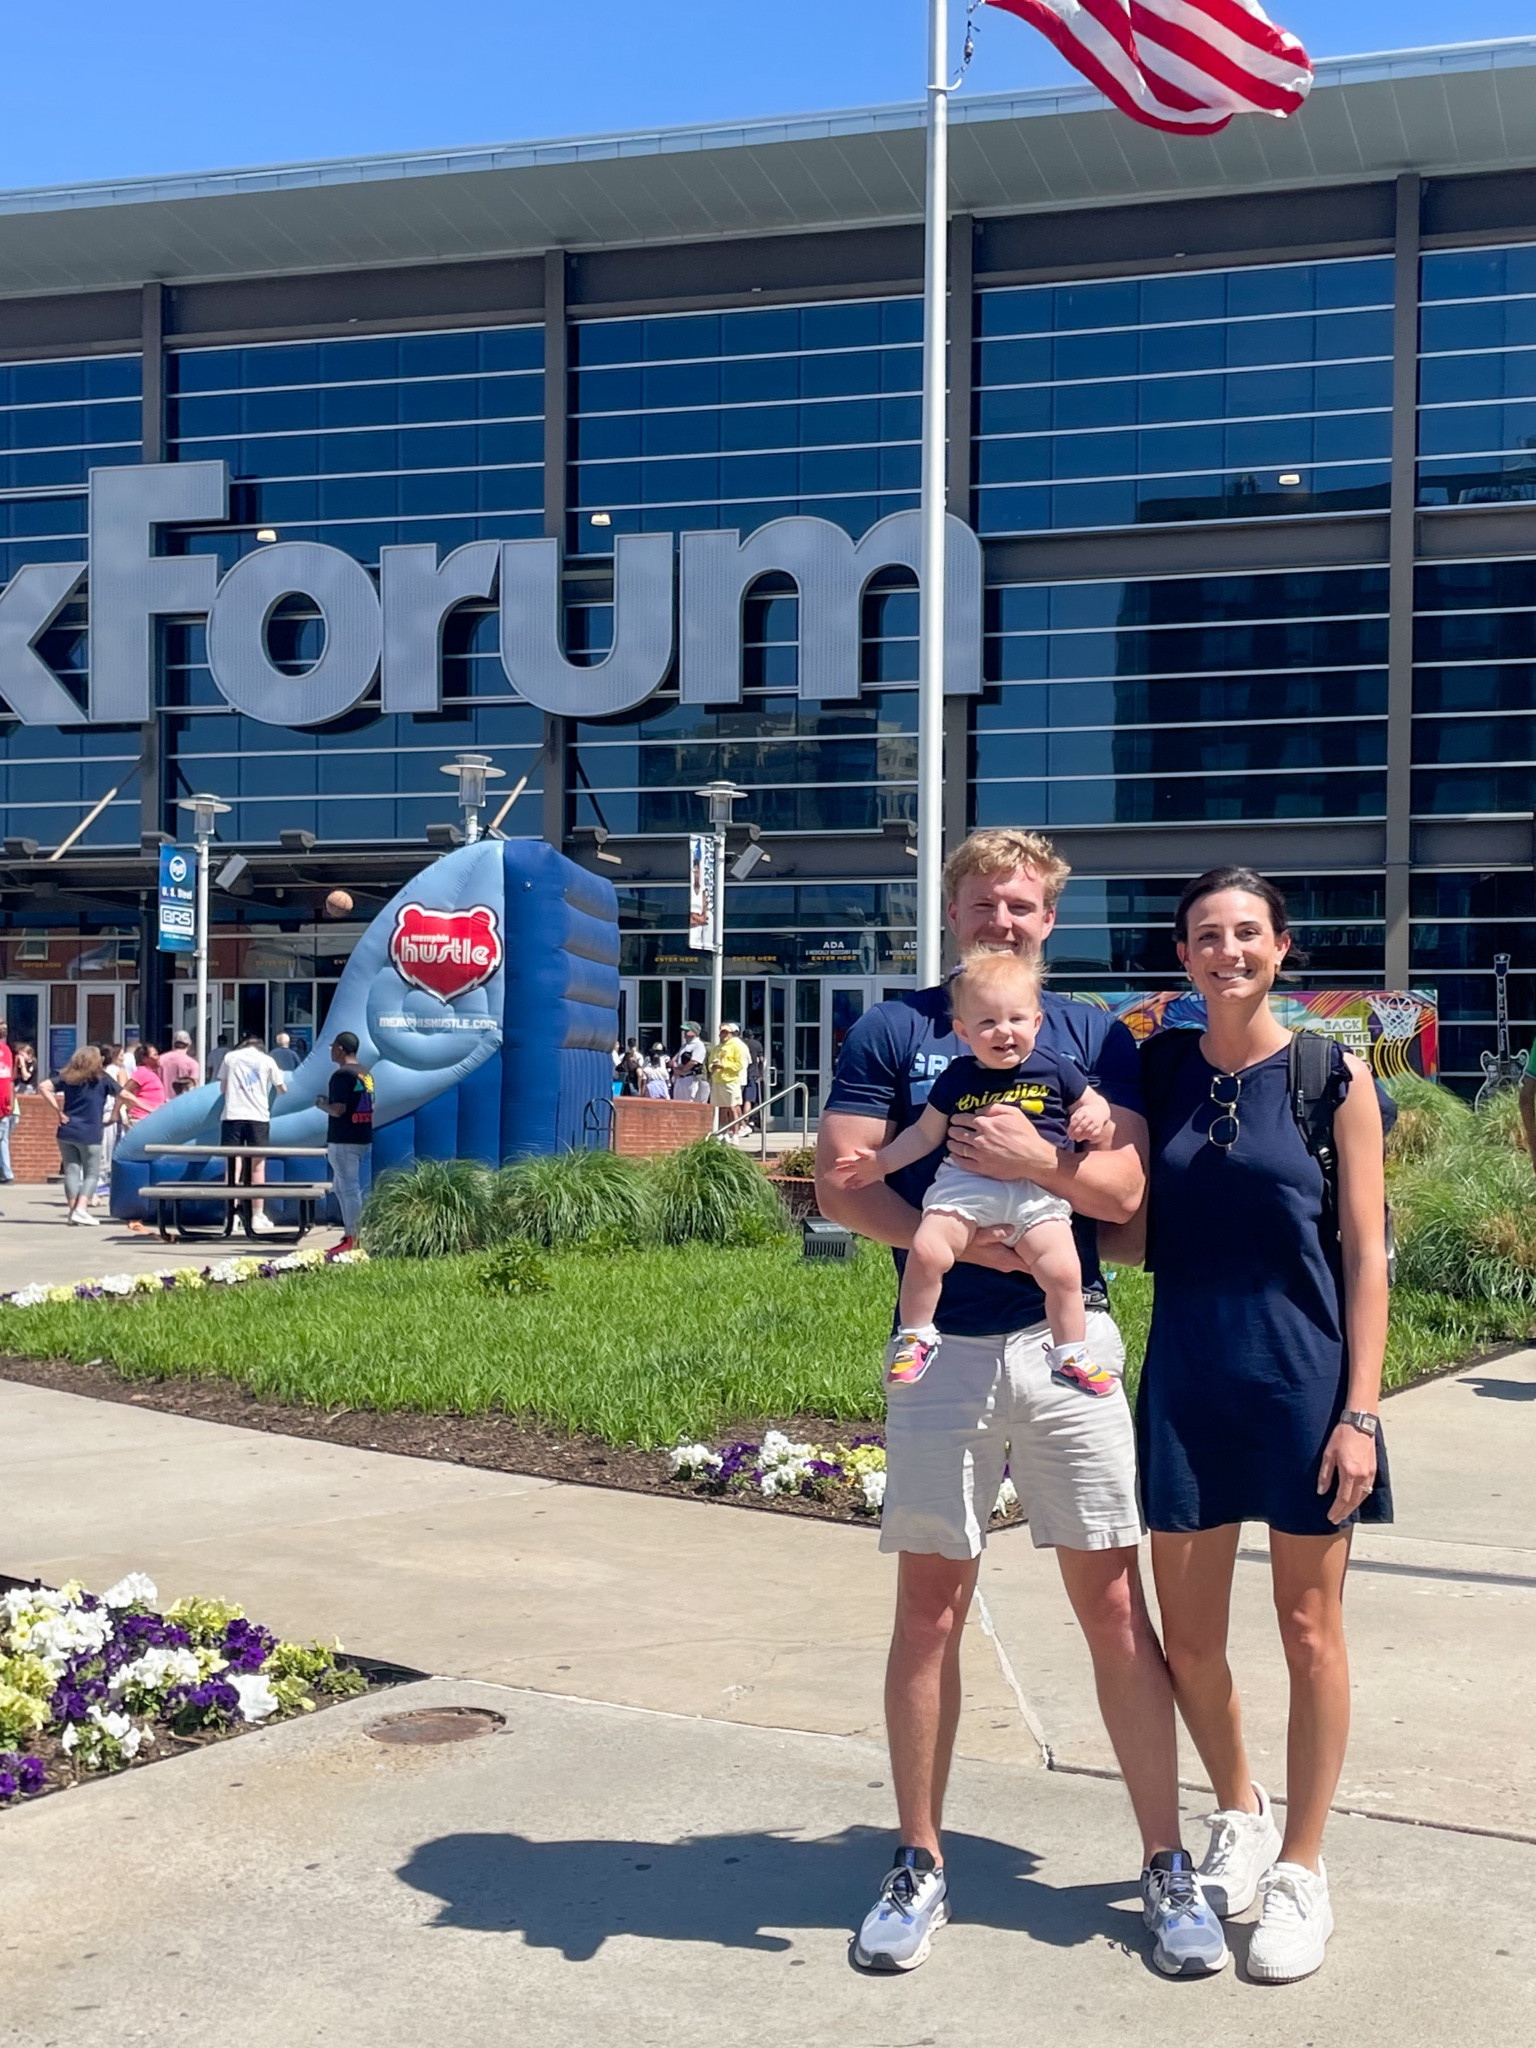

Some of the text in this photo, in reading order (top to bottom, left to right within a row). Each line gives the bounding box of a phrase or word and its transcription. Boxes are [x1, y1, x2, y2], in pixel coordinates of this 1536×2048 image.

[163, 909, 191, 926] BRS
[411, 934, 450, 944] memphis
[823, 941, 845, 949] ADA
[903, 941, 918, 949] AD
[401, 936, 490, 966] hustle
[1324, 1020, 1361, 1030] BACK
[1344, 1033, 1371, 1043] THE
[957, 1083, 1049, 1112] Grizzlies
